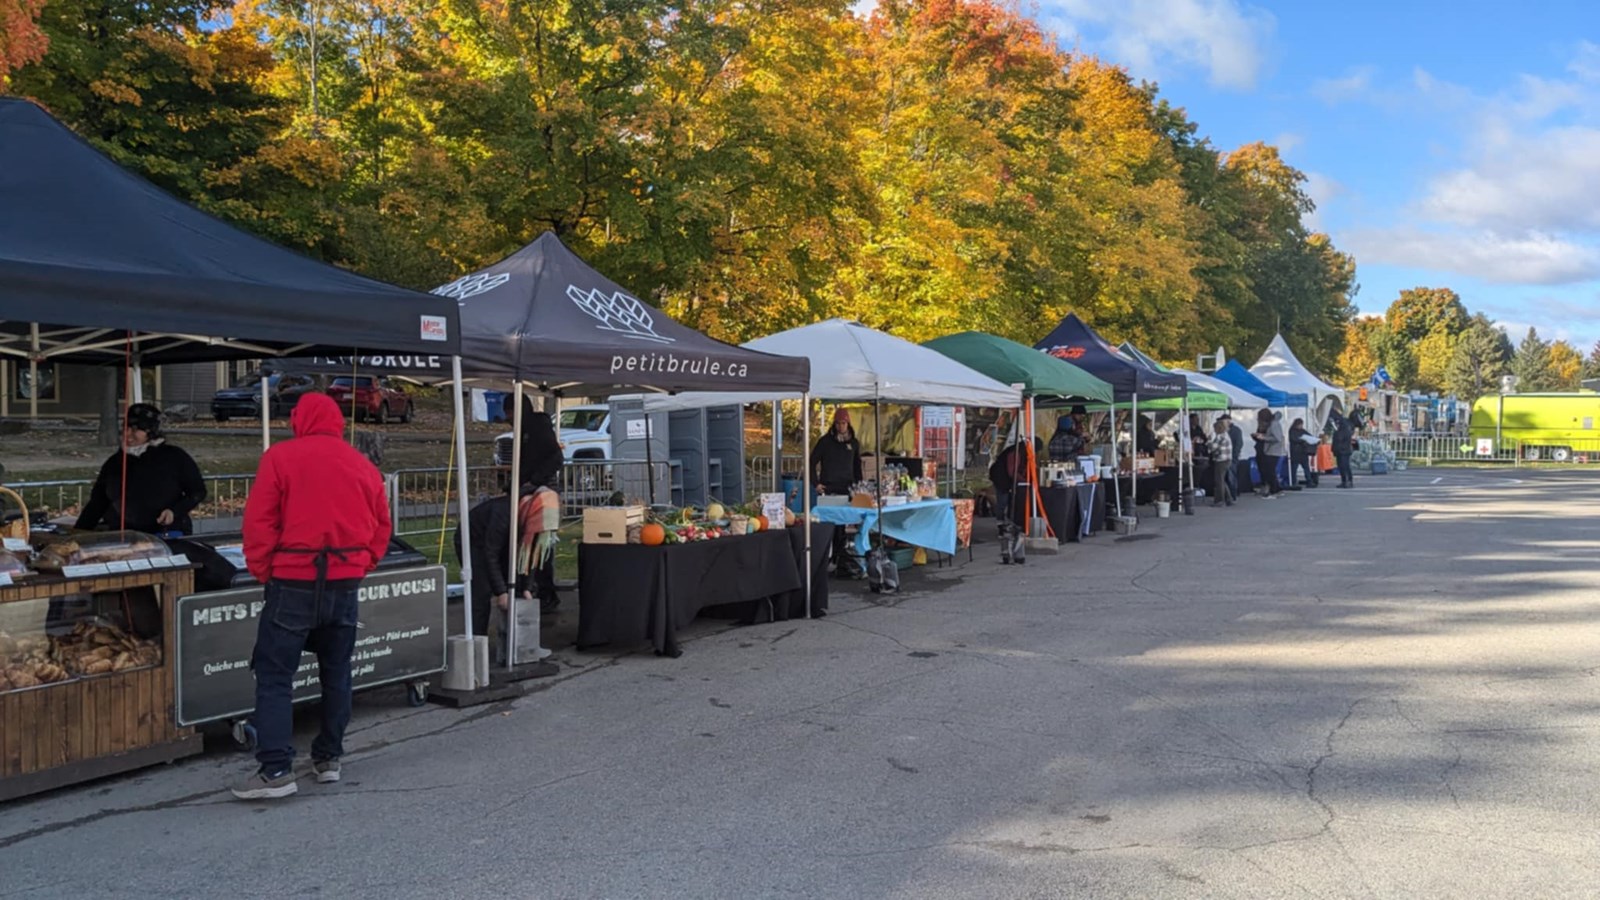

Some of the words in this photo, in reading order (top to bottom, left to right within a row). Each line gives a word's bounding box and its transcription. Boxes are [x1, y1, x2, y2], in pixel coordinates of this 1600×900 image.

[610, 352, 748, 377] petitbrule.ca
[193, 603, 248, 626] METS
[357, 584, 390, 602] OUR
[390, 578, 436, 597] VOUS!
[203, 660, 233, 676] Quiche
[233, 660, 249, 669] aux
[354, 634, 381, 647] ourtière
[410, 626, 430, 639] poulet
[370, 645, 393, 658] viande
